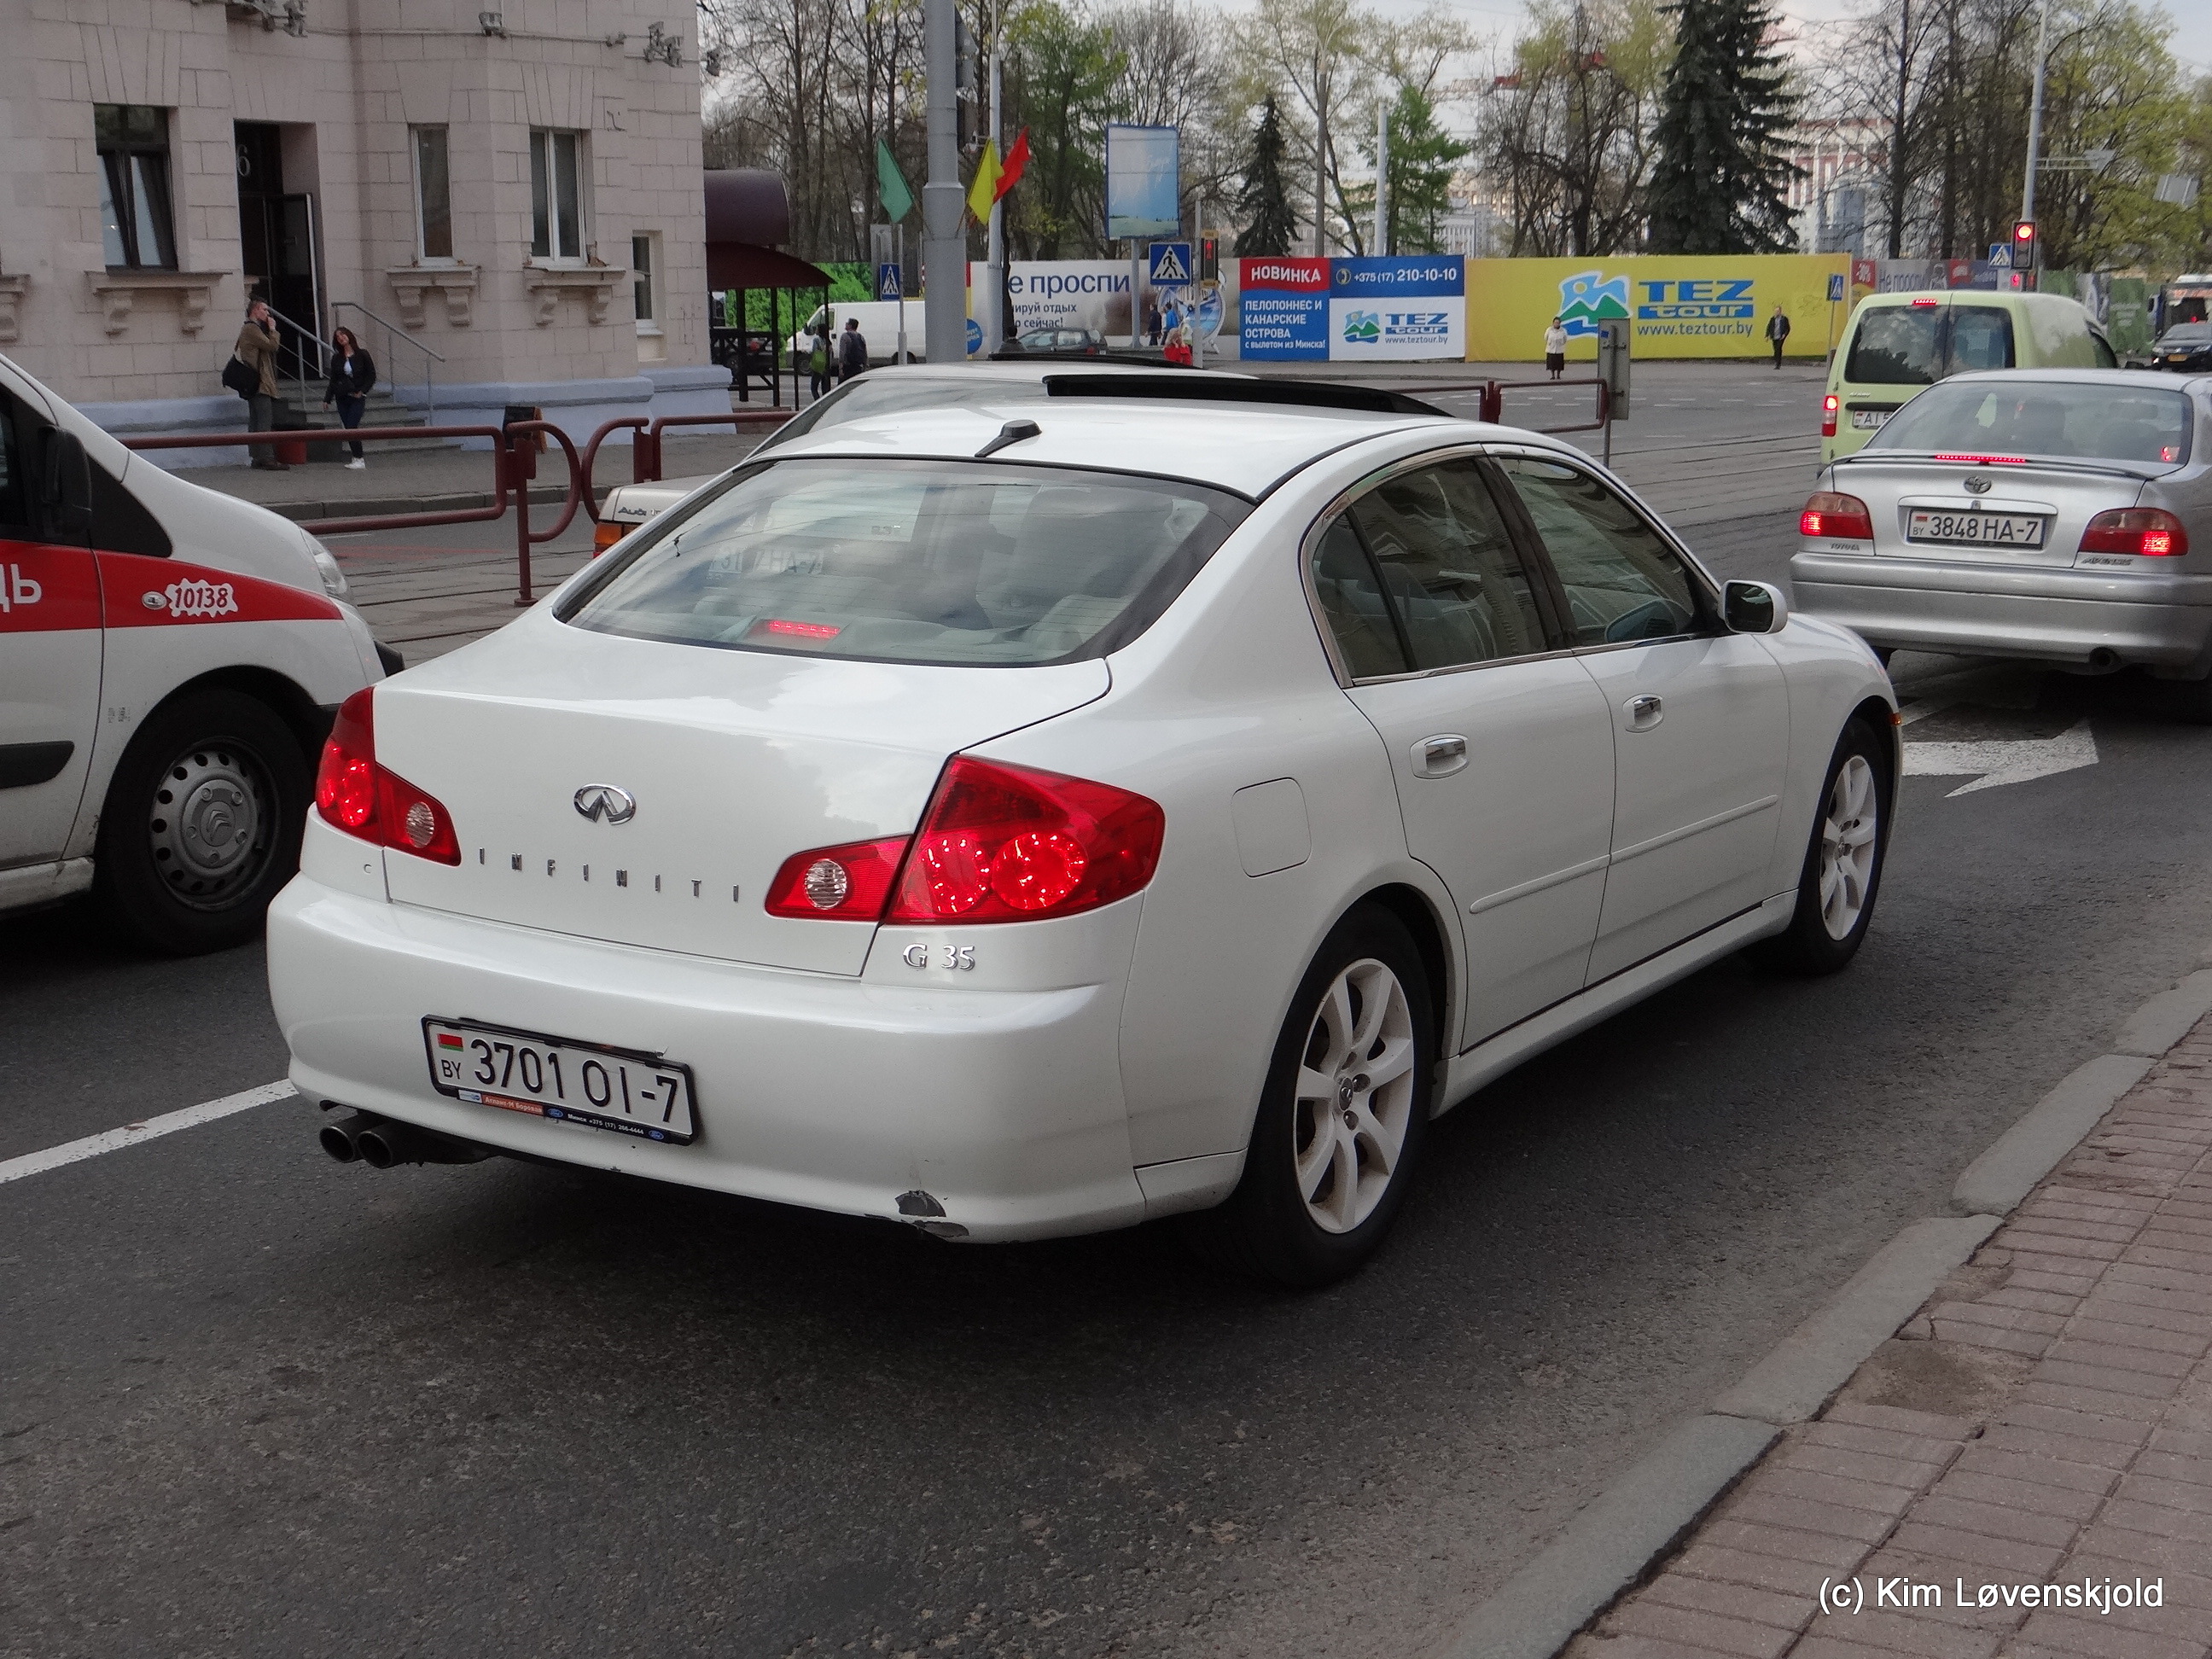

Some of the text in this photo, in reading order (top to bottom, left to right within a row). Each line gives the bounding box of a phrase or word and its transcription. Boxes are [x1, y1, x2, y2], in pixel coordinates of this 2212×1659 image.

[236, 143, 251, 178] 6
[1250, 265, 1321, 283] НОВИНКА
[1353, 267, 1457, 284] +375 (17) 210-10-10
[1030, 274, 1131, 299] проспи
[1638, 280, 1754, 302] TEZ
[1014, 302, 1077, 315] ируй отдых
[1245, 299, 1323, 311] ПЕЛОПОННЕС И
[1649, 305, 1743, 318] tour
[1024, 317, 1063, 329] сейчас!
[1245, 313, 1307, 325] КАНАРСКИЕ
[1385, 312, 1448, 326] TEZ
[1244, 328, 1291, 339] ОСТРОВА
[1394, 325, 1447, 335] tour
[1637, 321, 1754, 337] www.teztour.by
[1250, 341, 1284, 350] вылетом
[1284, 341, 1294, 350] из
[1295, 339, 1326, 350] Минска!
[1385, 335, 1449, 346] www.teztour.by
[618, 506, 647, 516] Audi
[1912, 515, 2039, 542] BY 3848 HA-7
[174, 587, 229, 609] 10138
[479, 847, 740, 903] INFINITI
[903, 943, 976, 971] G 35
[440, 1037, 678, 1123] BY 3701 OI-7
